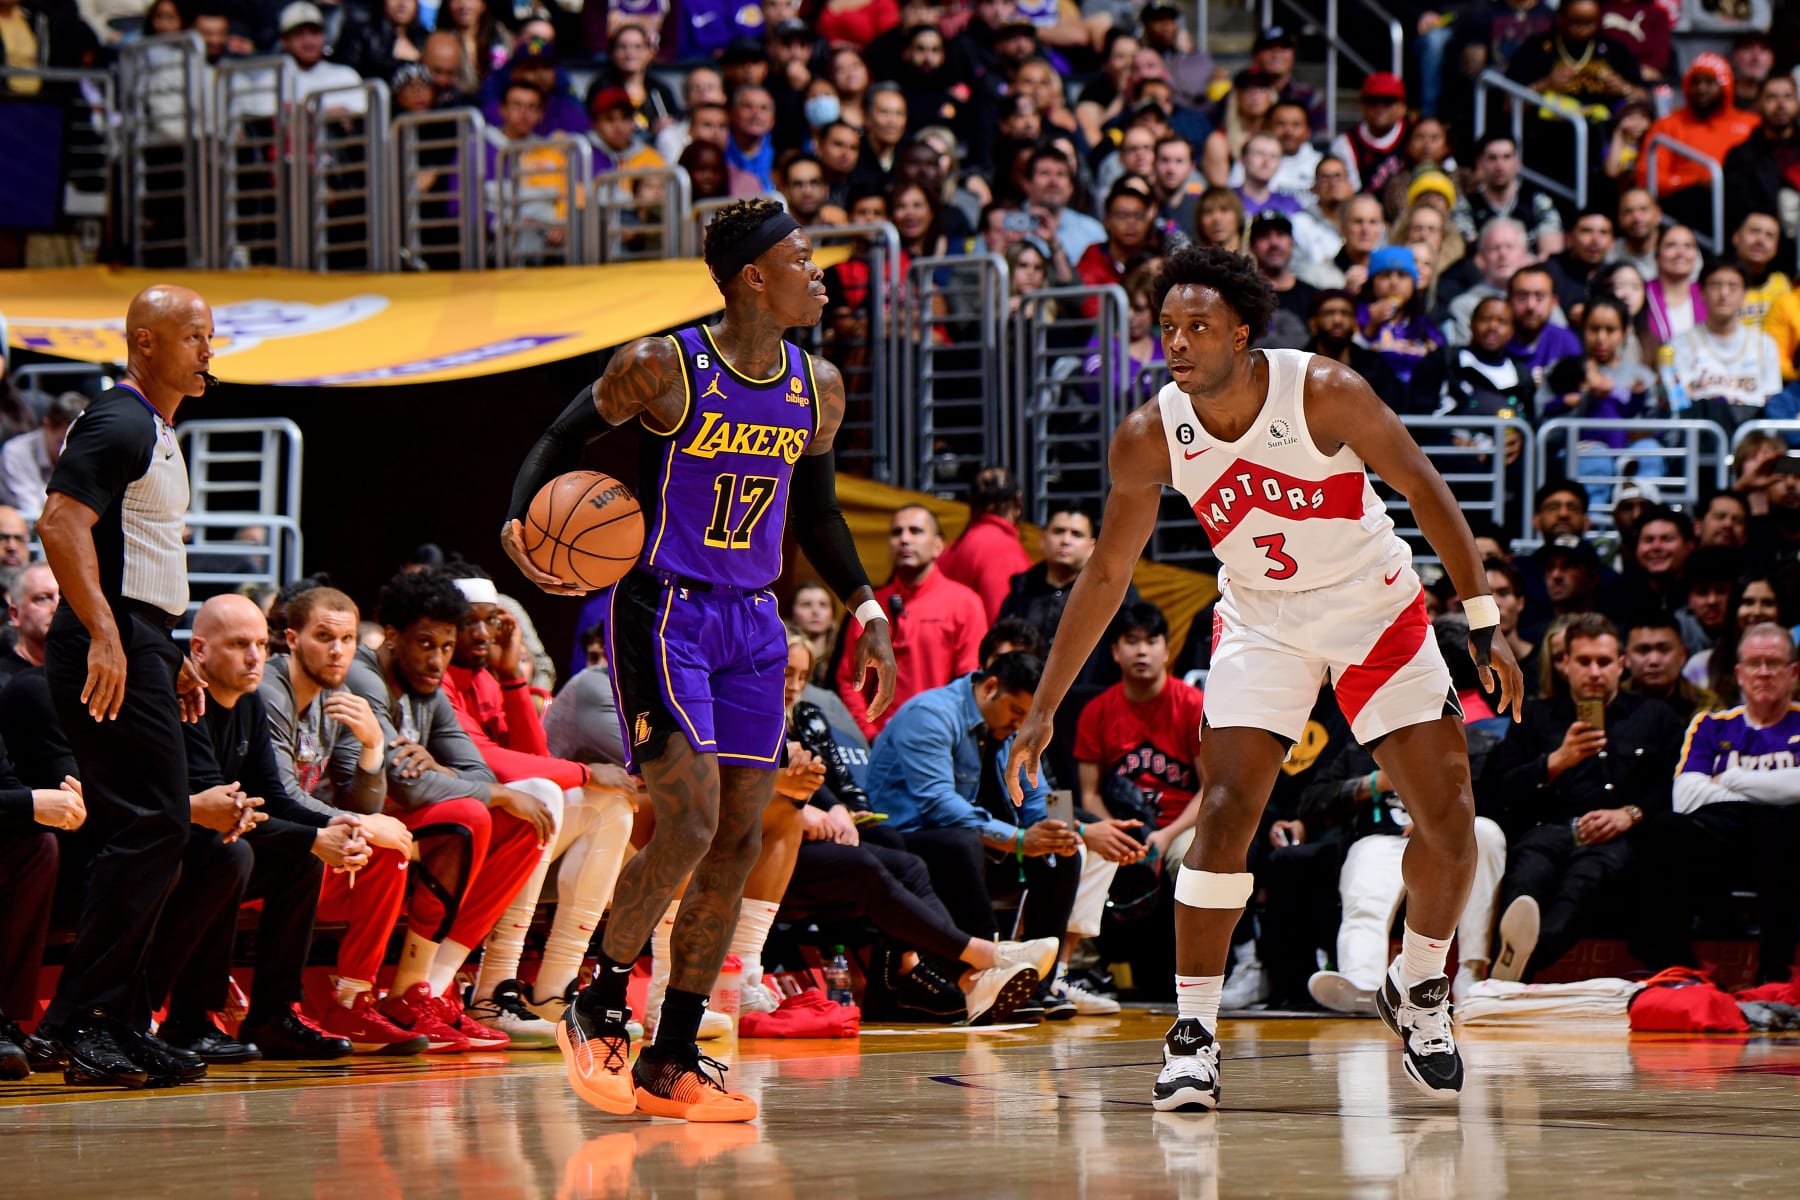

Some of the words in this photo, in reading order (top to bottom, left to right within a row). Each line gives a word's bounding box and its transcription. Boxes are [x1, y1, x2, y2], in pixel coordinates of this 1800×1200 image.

[696, 353, 709, 369] 6
[785, 393, 809, 407] bibigo
[681, 411, 809, 465] LAKERS
[1180, 426, 1191, 442] 6
[1267, 440, 1283, 449] Sun
[1283, 437, 1298, 446] Life
[703, 472, 779, 549] 17
[1252, 532, 1299, 581] 3
